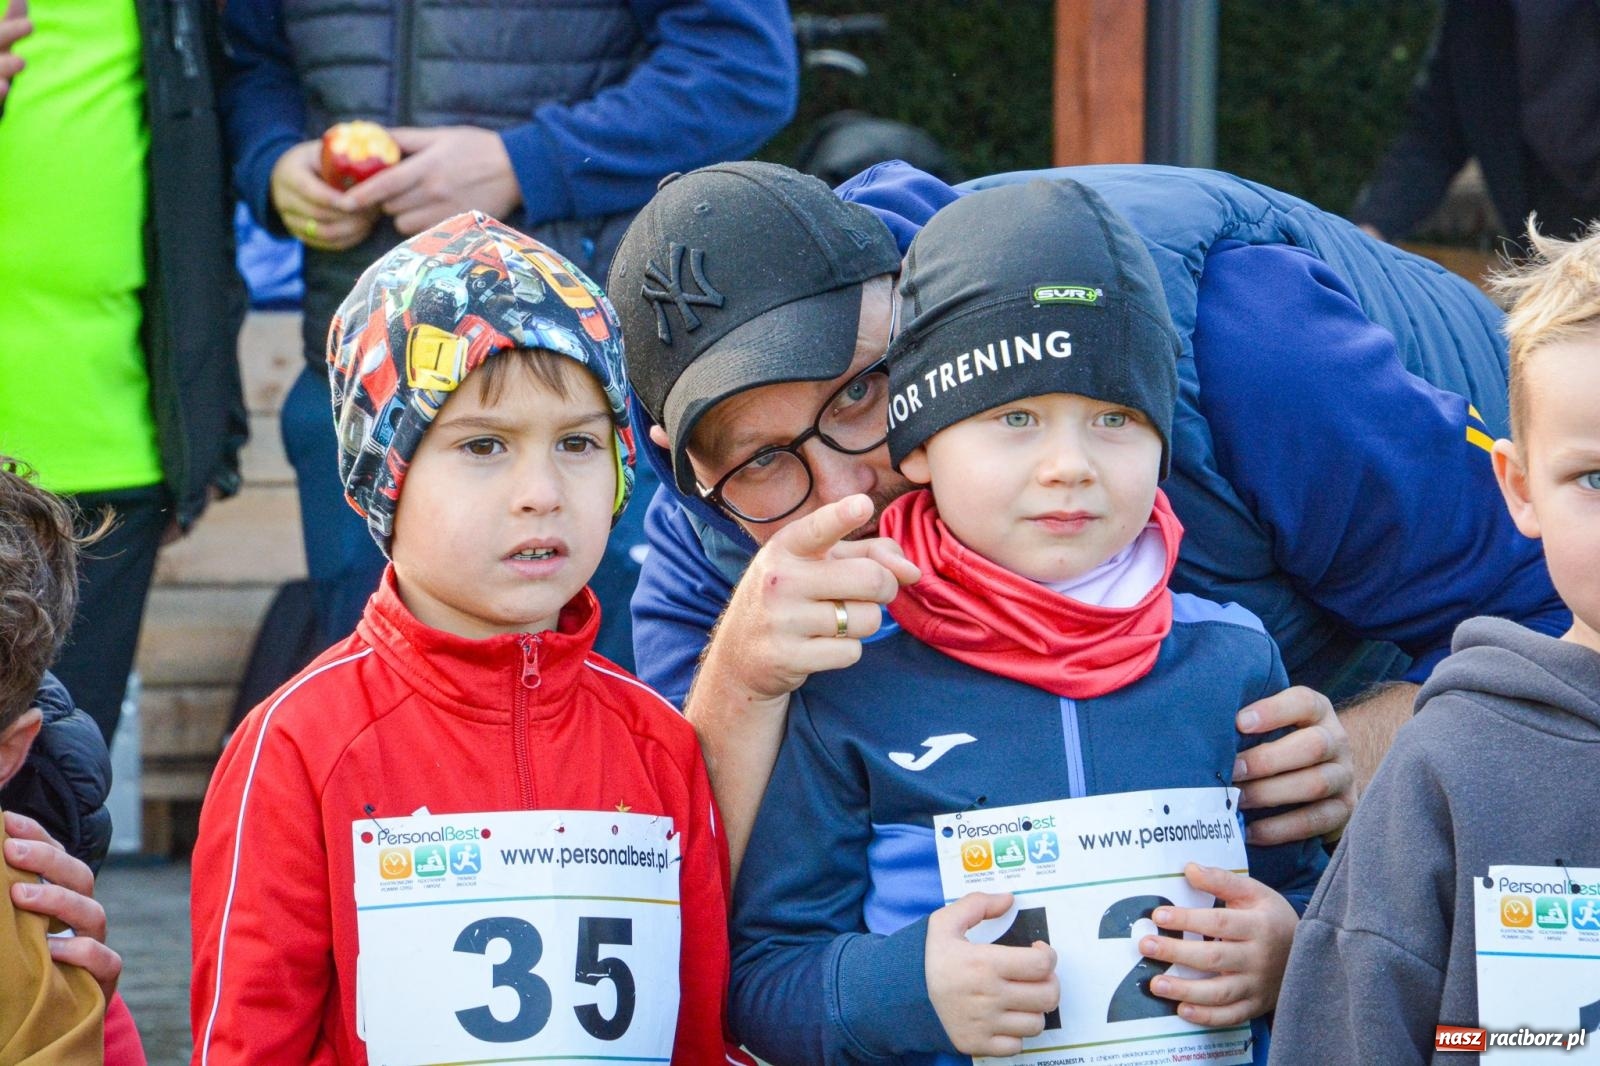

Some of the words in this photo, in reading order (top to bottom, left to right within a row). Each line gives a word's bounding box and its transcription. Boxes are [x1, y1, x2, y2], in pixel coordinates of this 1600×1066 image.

[640, 242, 725, 346] NY
[886, 384, 923, 433] IOR
[925, 330, 1073, 399] TRENING
[377, 825, 480, 846] PersonalBest
[500, 844, 669, 873] www.personalbest.pl
[1078, 818, 1235, 851] www.personalbest.pl
[453, 916, 636, 1043] 35
